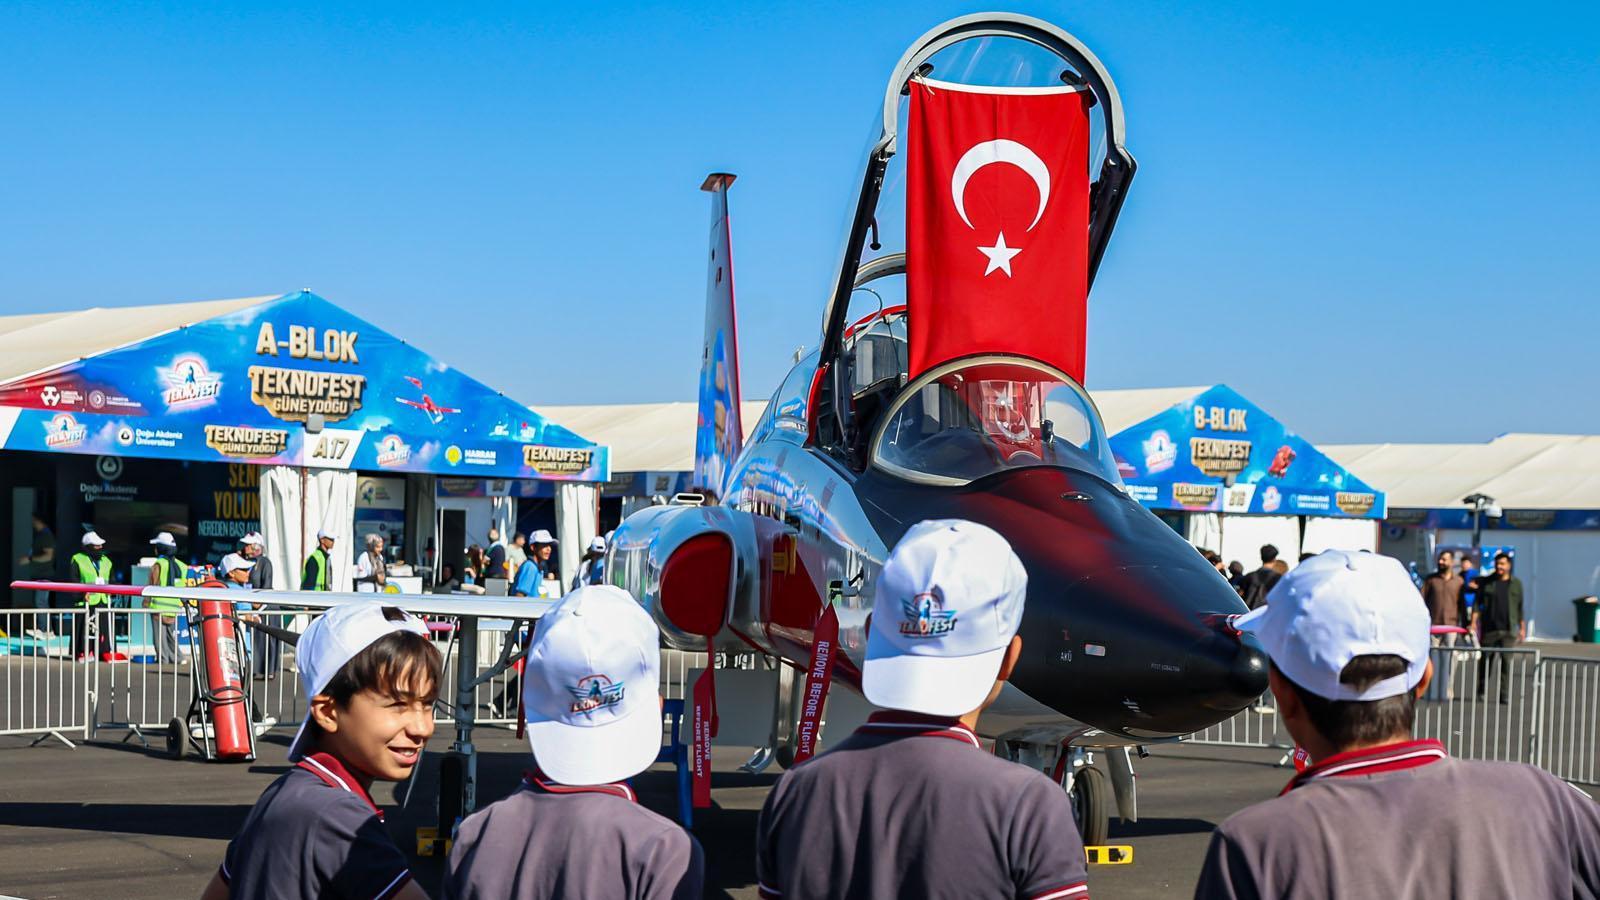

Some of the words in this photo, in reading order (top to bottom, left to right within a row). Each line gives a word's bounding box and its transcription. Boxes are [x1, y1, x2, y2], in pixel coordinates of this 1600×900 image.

[255, 321, 360, 364] A-BLOK
[248, 366, 366, 399] TEKNOFEST
[1194, 405, 1248, 432] B-BLOK
[204, 426, 288, 445] TEKNOFEST
[312, 437, 350, 460] A17
[522, 445, 593, 463] TEKNOFEST
[229, 463, 260, 488] SEN
[813, 640, 830, 679] REMOVE
[805, 682, 823, 718] BEFORE
[801, 721, 814, 755] FLIGHT
